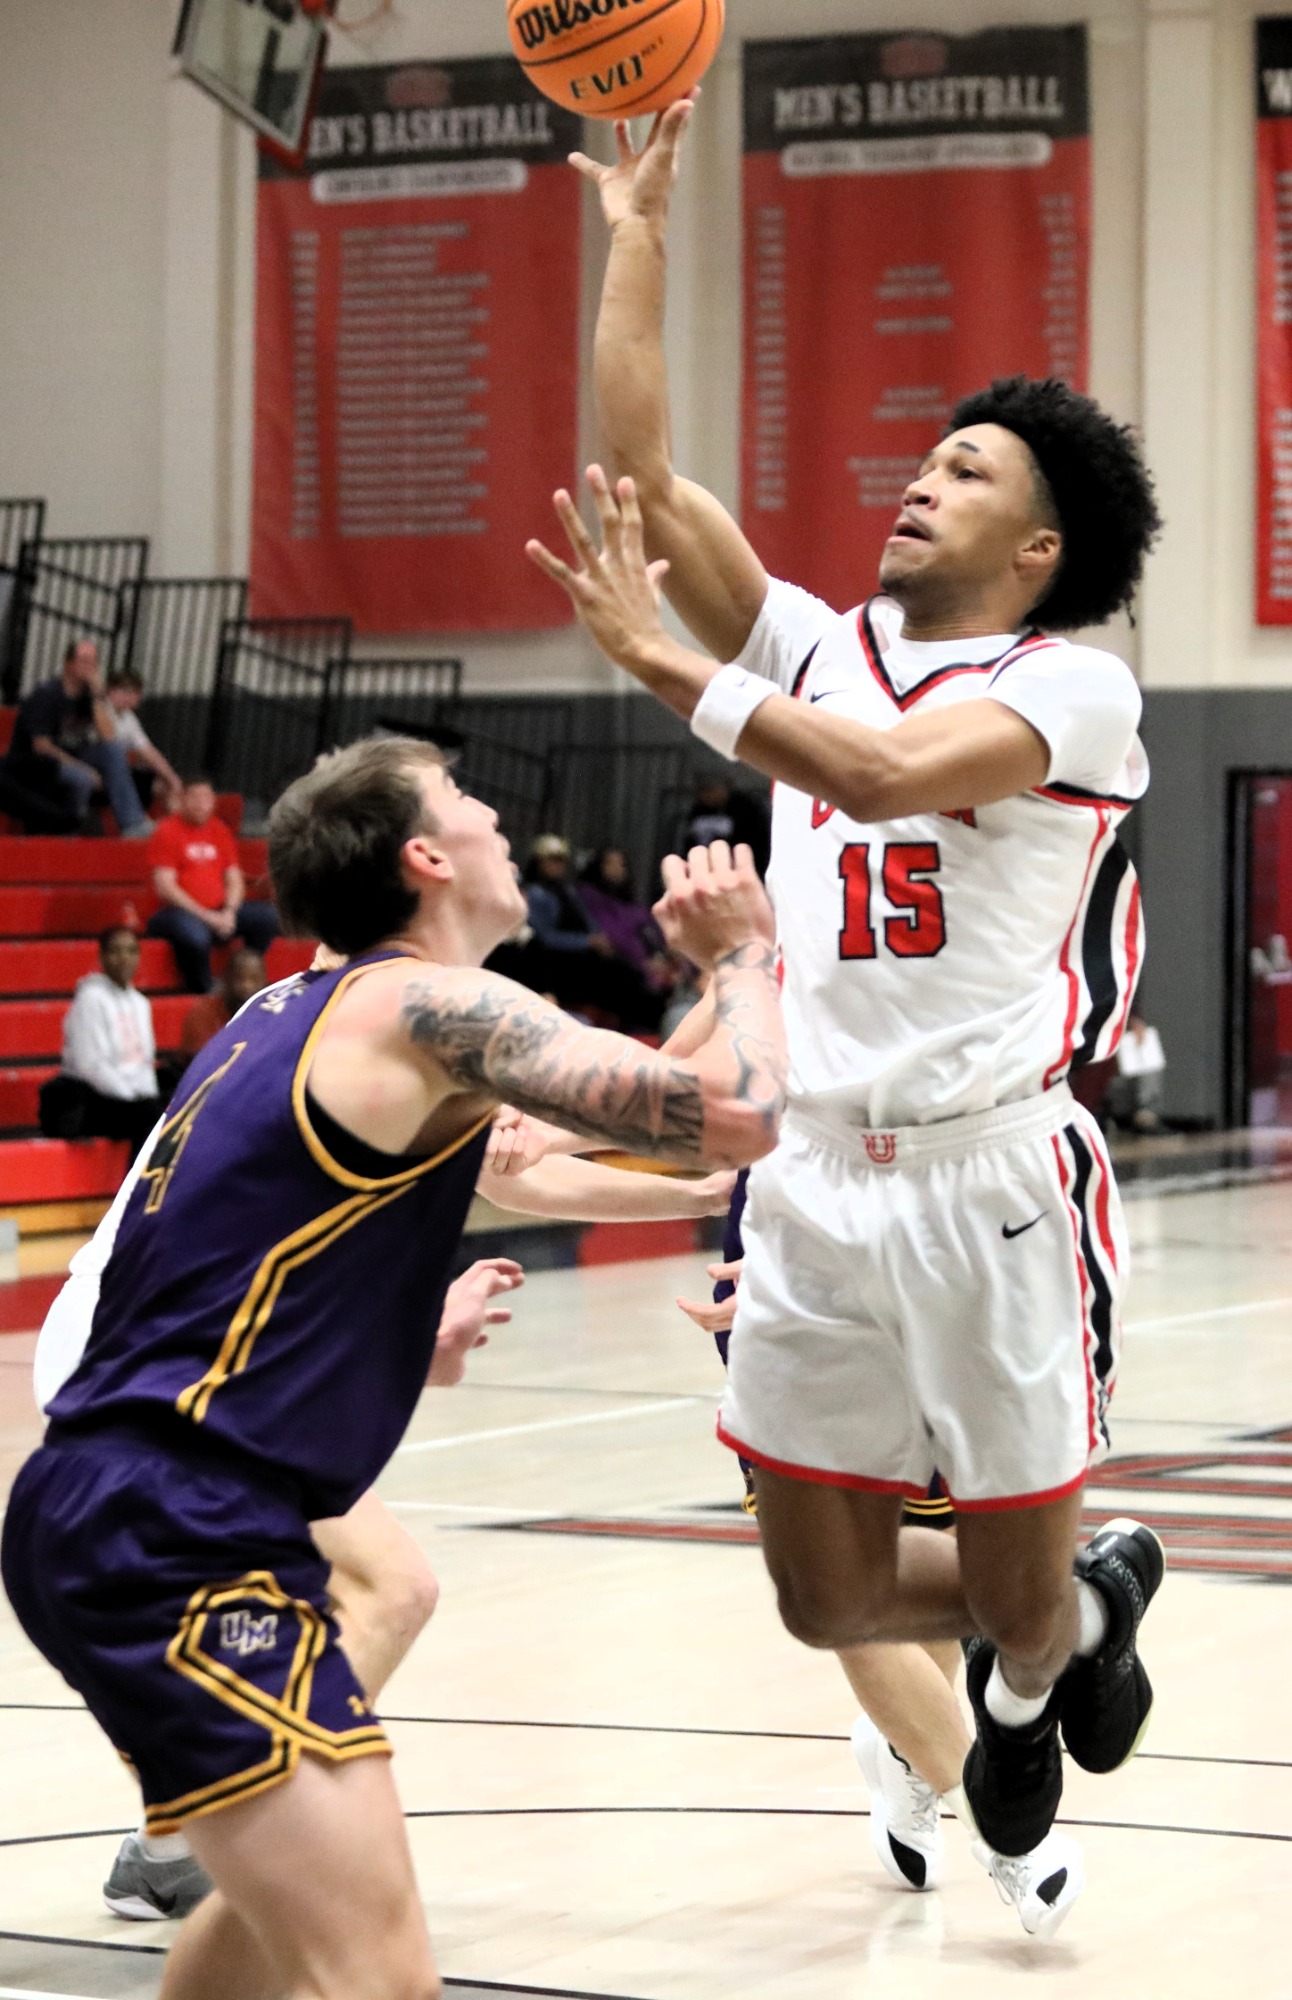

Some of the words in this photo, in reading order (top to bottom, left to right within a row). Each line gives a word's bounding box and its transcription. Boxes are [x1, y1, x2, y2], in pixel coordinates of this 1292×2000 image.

[308, 116, 366, 158] EN'S
[371, 102, 551, 154] BASKETBALL
[774, 84, 862, 130] MEN'S
[868, 75, 1063, 126] BASKETBALL
[838, 841, 946, 960] 15
